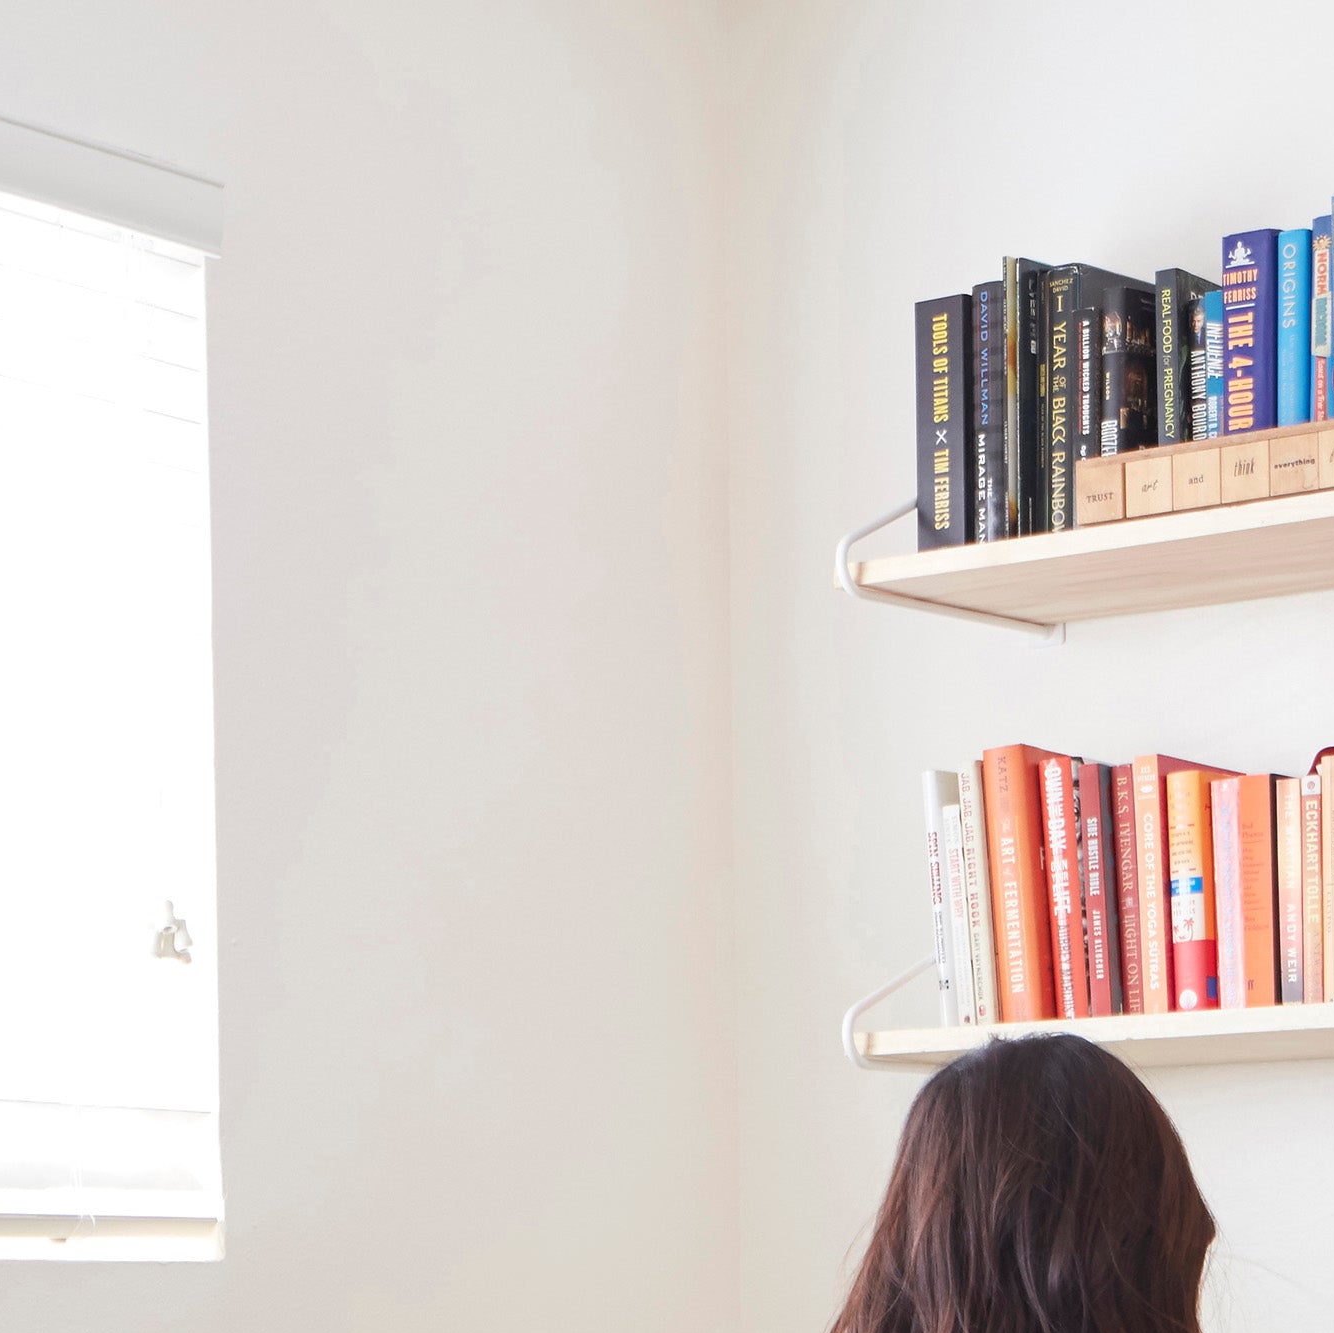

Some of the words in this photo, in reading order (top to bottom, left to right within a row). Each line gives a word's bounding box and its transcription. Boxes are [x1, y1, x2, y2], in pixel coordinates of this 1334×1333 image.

[1049, 277, 1074, 288] SANCHEZ
[1052, 286, 1069, 294] DAVID
[1223, 268, 1258, 287] TIMOTHY
[1282, 243, 1297, 329] ORIGINS
[1317, 252, 1327, 296] NORM
[1161, 289, 1171, 319] REAL
[1223, 287, 1257, 304] FERRISS
[932, 313, 950, 356] TOOLS
[979, 291, 989, 342] DAVID
[1228, 311, 1254, 350] THE
[1052, 321, 1067, 371] YEAR
[1081, 329, 1090, 360] BILLION
[1162, 320, 1173, 353] FOOD
[1206, 321, 1223, 379] INFLUENCE
[932, 358, 949, 374] OF
[1082, 361, 1090, 392] WICKED
[1162, 355, 1172, 367] for
[1191, 350, 1207, 400] ANTHONY
[933, 377, 950, 424] TITANS
[980, 348, 989, 425] WILLMAN
[1163, 368, 1176, 439] PREGNANCY
[1228, 356, 1255, 431] 4-HOUR
[1052, 396, 1067, 446] BLACK
[1082, 394, 1090, 436] THOUGHTS
[934, 448, 950, 475] TIM
[977, 434, 986, 501] MIRAGE
[1086, 492, 1115, 504] TRUST
[1141, 480, 1160, 493] art
[1188, 475, 1204, 484] and
[1233, 460, 1256, 477] think
[1273, 456, 1316, 470] everything
[934, 476, 951, 531] FERRISS
[997, 756, 1009, 793] KATZ
[1086, 817, 1098, 837] SIDE
[1143, 813, 1155, 850] CORE
[1305, 800, 1319, 872] ECKHART
[948, 848, 959, 875] START
[967, 848, 978, 886] RIGHT
[1000, 837, 1016, 865] ART
[1087, 839, 1099, 871] HUSTLE
[1119, 822, 1134, 892] IYENGAR
[1144, 853, 1156, 871] OF
[1089, 872, 1101, 897] BIBLE
[1145, 873, 1157, 898] THE
[1307, 874, 1320, 924] TOLLE
[970, 891, 981, 928] HOOK
[1146, 901, 1158, 938] YOGA
[1286, 903, 1297, 941] ANDY
[1003, 881, 1024, 993] FERMENTATION
[1123, 914, 1139, 960] LIGHT
[1126, 964, 1140, 986] ON
[1287, 947, 1297, 983] WEIR
